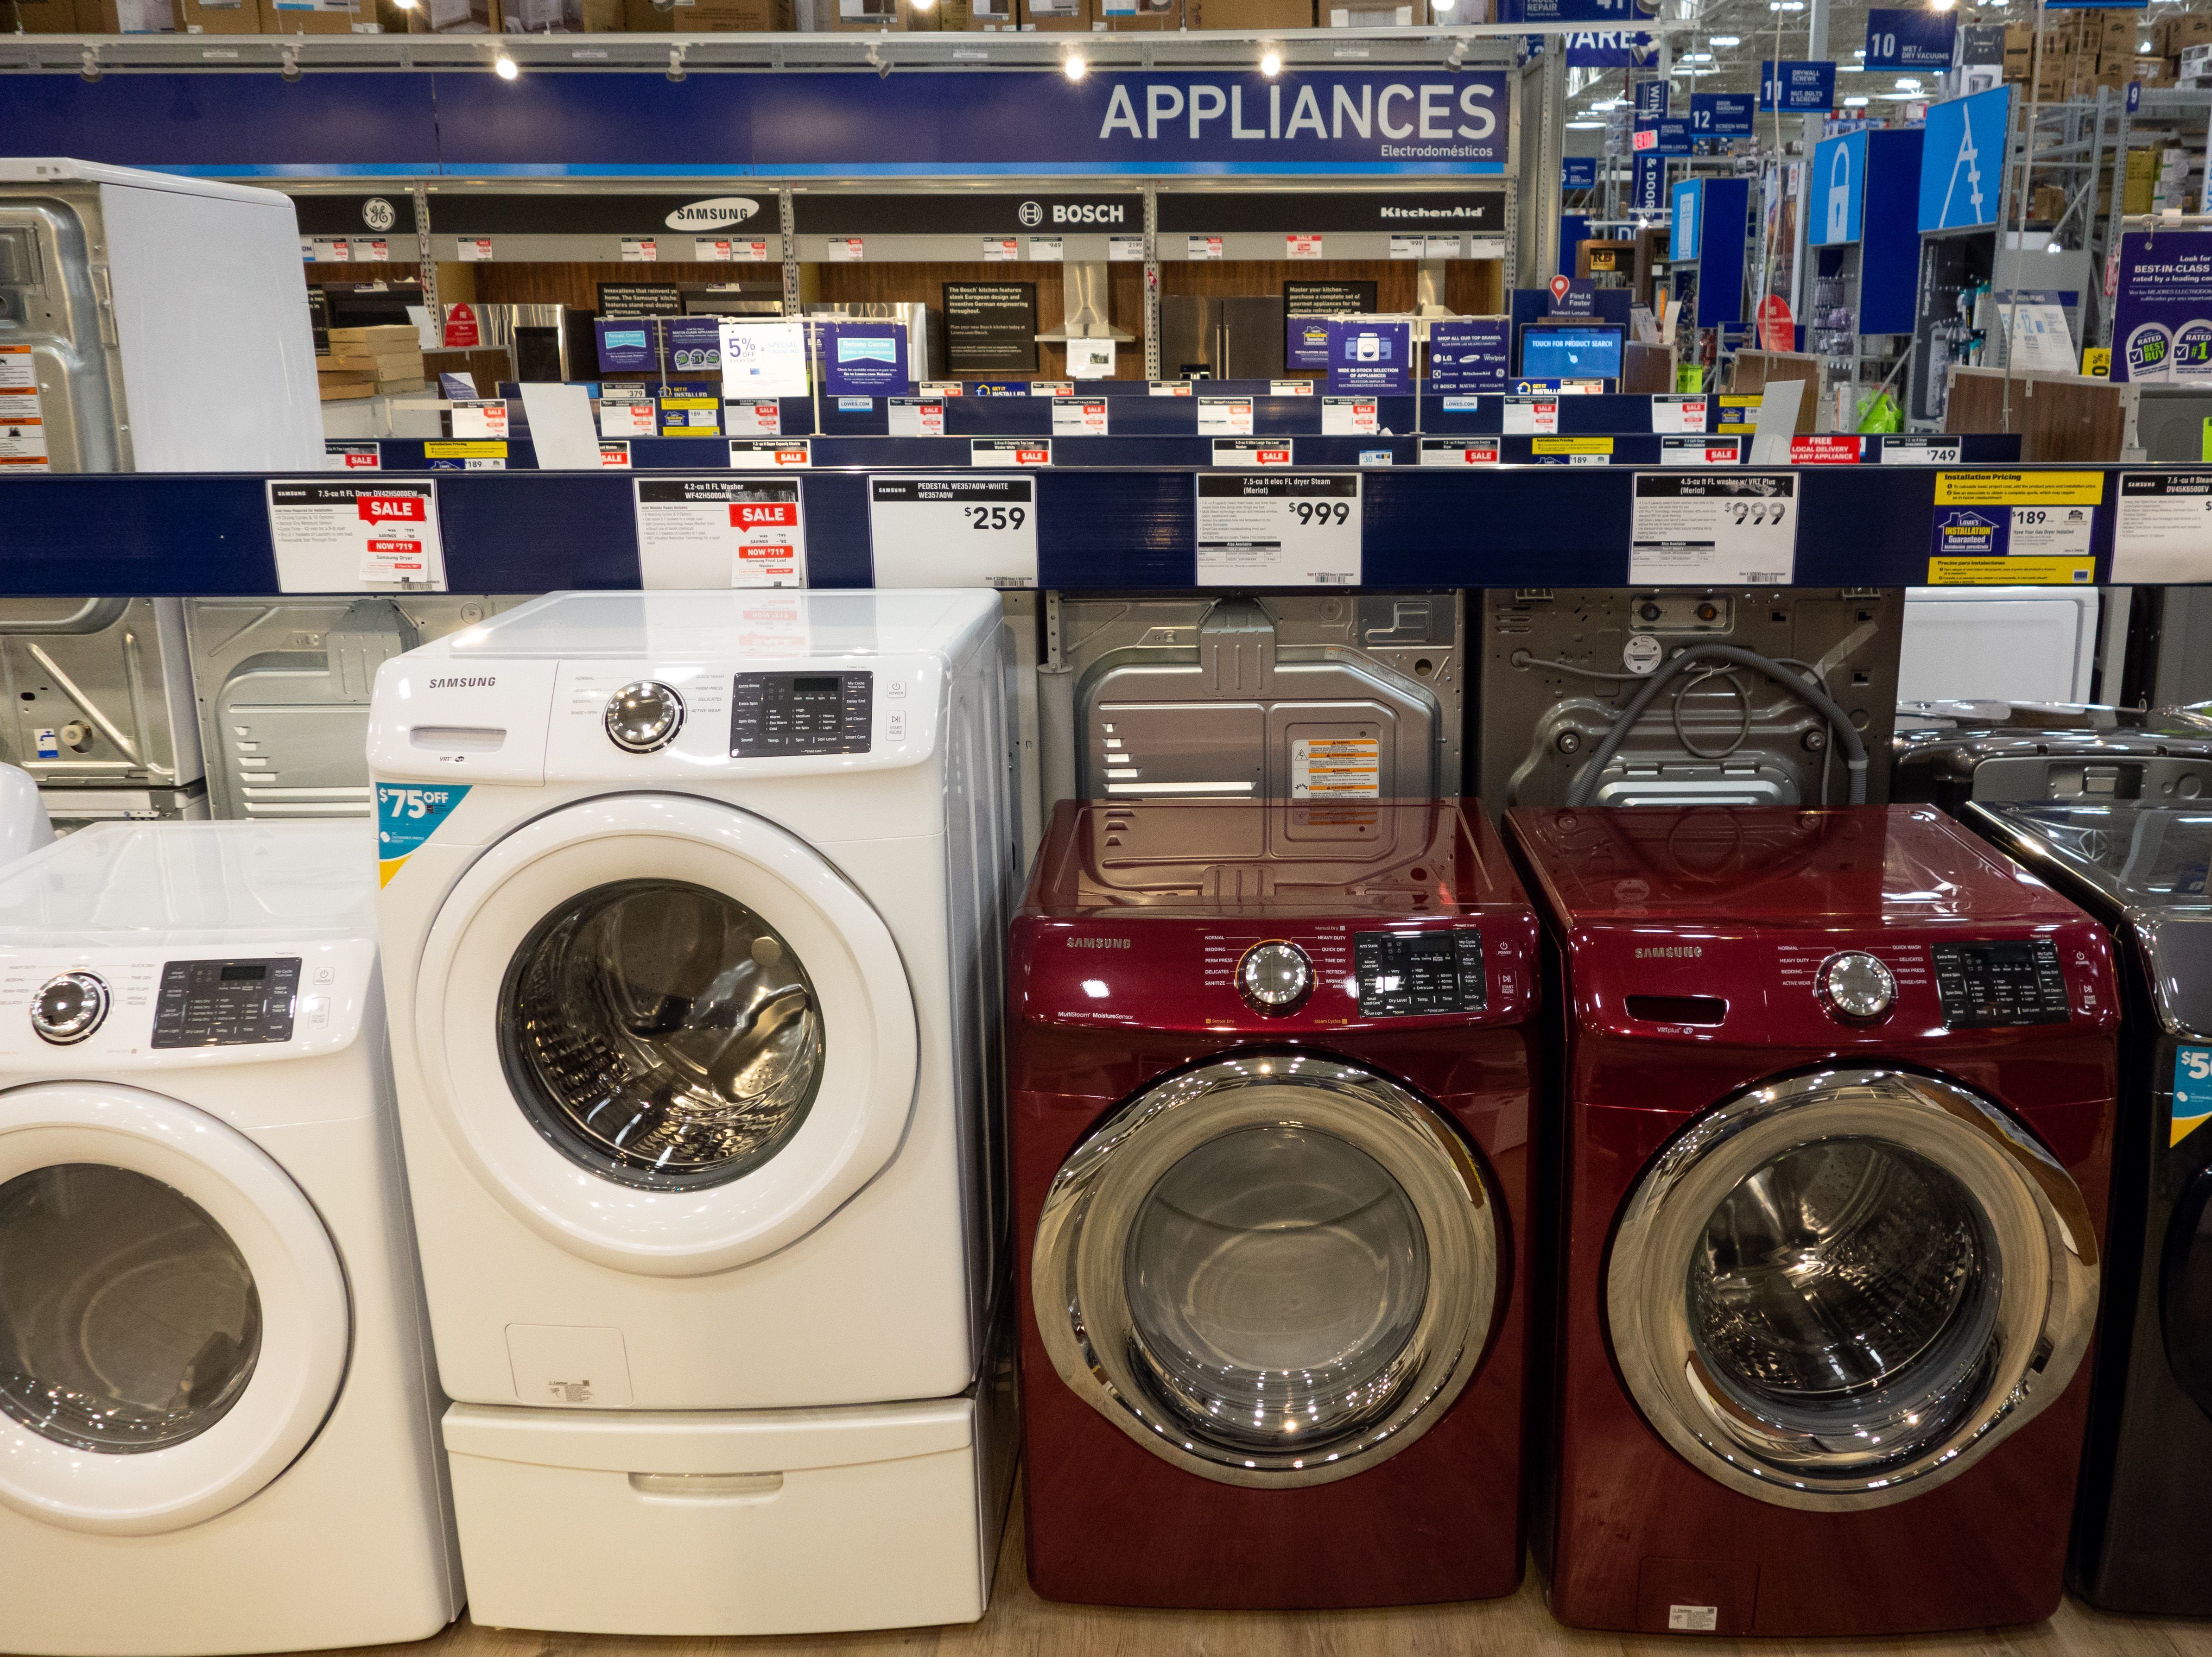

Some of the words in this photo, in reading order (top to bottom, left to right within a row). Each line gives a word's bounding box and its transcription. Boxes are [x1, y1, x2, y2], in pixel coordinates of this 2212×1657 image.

[1872, 33, 1895, 57] 10
[1100, 84, 1496, 139] APPLIANCES
[1693, 111, 1710, 128] 12
[1637, 132, 1652, 149] EXIT
[1381, 145, 1493, 158] Electrodomésticos
[677, 209, 748, 220] SAMSUNG
[1053, 205, 1123, 222] BOSCH
[1381, 207, 1483, 217] KitchenAid
[2137, 335, 2161, 345] RATED
[2144, 341, 2165, 352] BEST
[2145, 349, 2165, 362] BUY
[1927, 450, 1956, 461] $749
[371, 501, 412, 516] SALE
[742, 508, 784, 521] SALE
[1289, 501, 1350, 525] $999
[1724, 501, 1785, 525] $999
[964, 506, 1025, 530] $259
[2012, 511, 2046, 524] $189
[1945, 527, 1991, 535] INSTALLATION
[429, 677, 495, 688] SAMSUNG
[379, 788, 426, 818] $75
[423, 792, 448, 803] OFF
[1067, 937, 1131, 949] SAMSUNG
[1635, 947, 1702, 958] SAMSUNG
